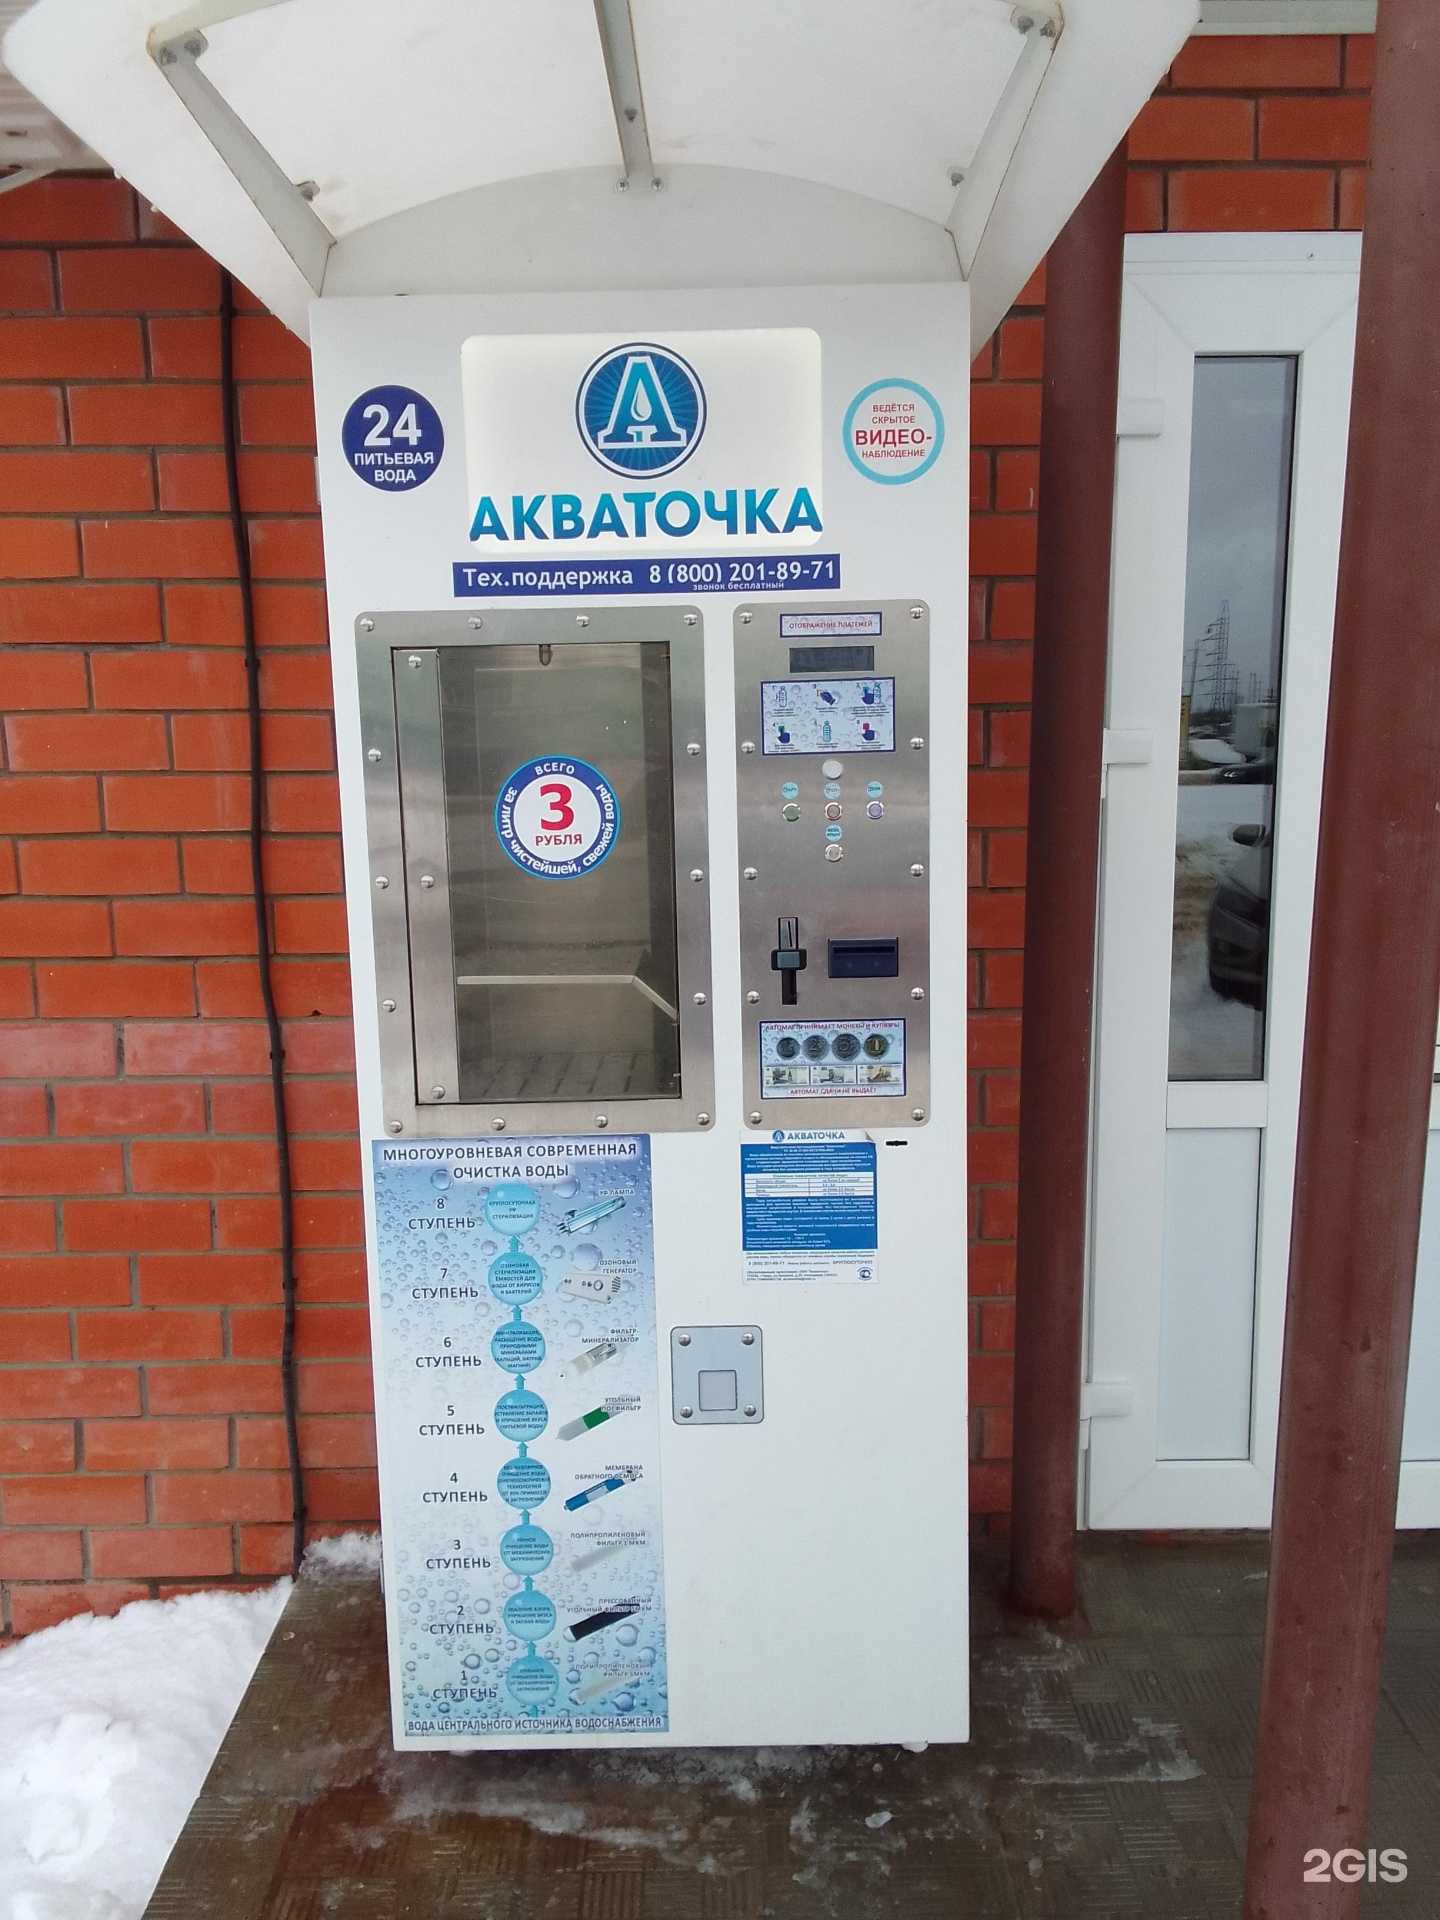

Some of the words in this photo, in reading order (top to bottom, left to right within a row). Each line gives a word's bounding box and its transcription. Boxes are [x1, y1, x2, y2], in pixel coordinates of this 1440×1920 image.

[872, 403, 916, 413] ВЕДЁТСЯ
[362, 403, 422, 446] 24
[871, 415, 916, 425] СКРЫТОЕ
[855, 428, 932, 448] ВИДЕО-
[353, 451, 435, 466] ПИТЬЕВАЯ
[861, 449, 926, 459] НАБЛЮДЕНИЕ
[374, 468, 417, 484] ВОДА
[468, 487, 824, 543] АКВАТОЧКА
[462, 568, 634, 590] Тех.поддержка
[649, 565, 661, 584] 8
[667, 562, 722, 584] (800)
[729, 559, 835, 583] 201-89-71
[692, 583, 726, 591] звонок
[727, 579, 785, 591] бесплатный
[534, 762, 575, 776] ВСЕГО
[503, 786, 518, 804] за
[594, 783, 616, 820] воды
[539, 783, 575, 831] 3
[500, 803, 514, 839] литр
[535, 833, 582, 847] РУБЛЯ
[582, 821, 616, 867] свежей
[787, 1130, 845, 1141] АКВАТОЧКА
[383, 1145, 522, 1161] МНОГОУРОВНЕВАЯ
[526, 1143, 637, 1157] СОВРЕМЕННАЯ
[453, 1166, 521, 1179] ОЧИСТКА
[525, 1164, 569, 1179] ВОДЫ
[437, 1198, 445, 1210] 8
[408, 1217, 476, 1230] СТУПЕНЬ
[440, 1267, 448, 1279] 7
[411, 1287, 479, 1300] СТУПЕНЬ
[443, 1336, 452, 1348] 6
[415, 1355, 482, 1368] СТУПЕНЬ
[447, 1405, 455, 1416] 5
[418, 1423, 485, 1436] СТУПЕНЬ
[449, 1472, 458, 1484] 4
[422, 1490, 488, 1503] СТУПЕНЬ
[453, 1539, 461, 1551] 3
[426, 1557, 491, 1570] СТУПЕНЬ
[456, 1604, 465, 1616] 2
[429, 1622, 495, 1635] СТУПЕНЬ
[460, 1669, 468, 1681] 1
[432, 1687, 497, 1699] СТУПЕНЬ
[408, 1720, 436, 1731] ВОДА
[437, 1719, 513, 1731] ЦЕНТРАЛЬНОГО
[515, 1718, 573, 1729] ИСТОЧНИКА
[575, 1716, 662, 1729] ВОДОСНАБЖЕНИЯ
